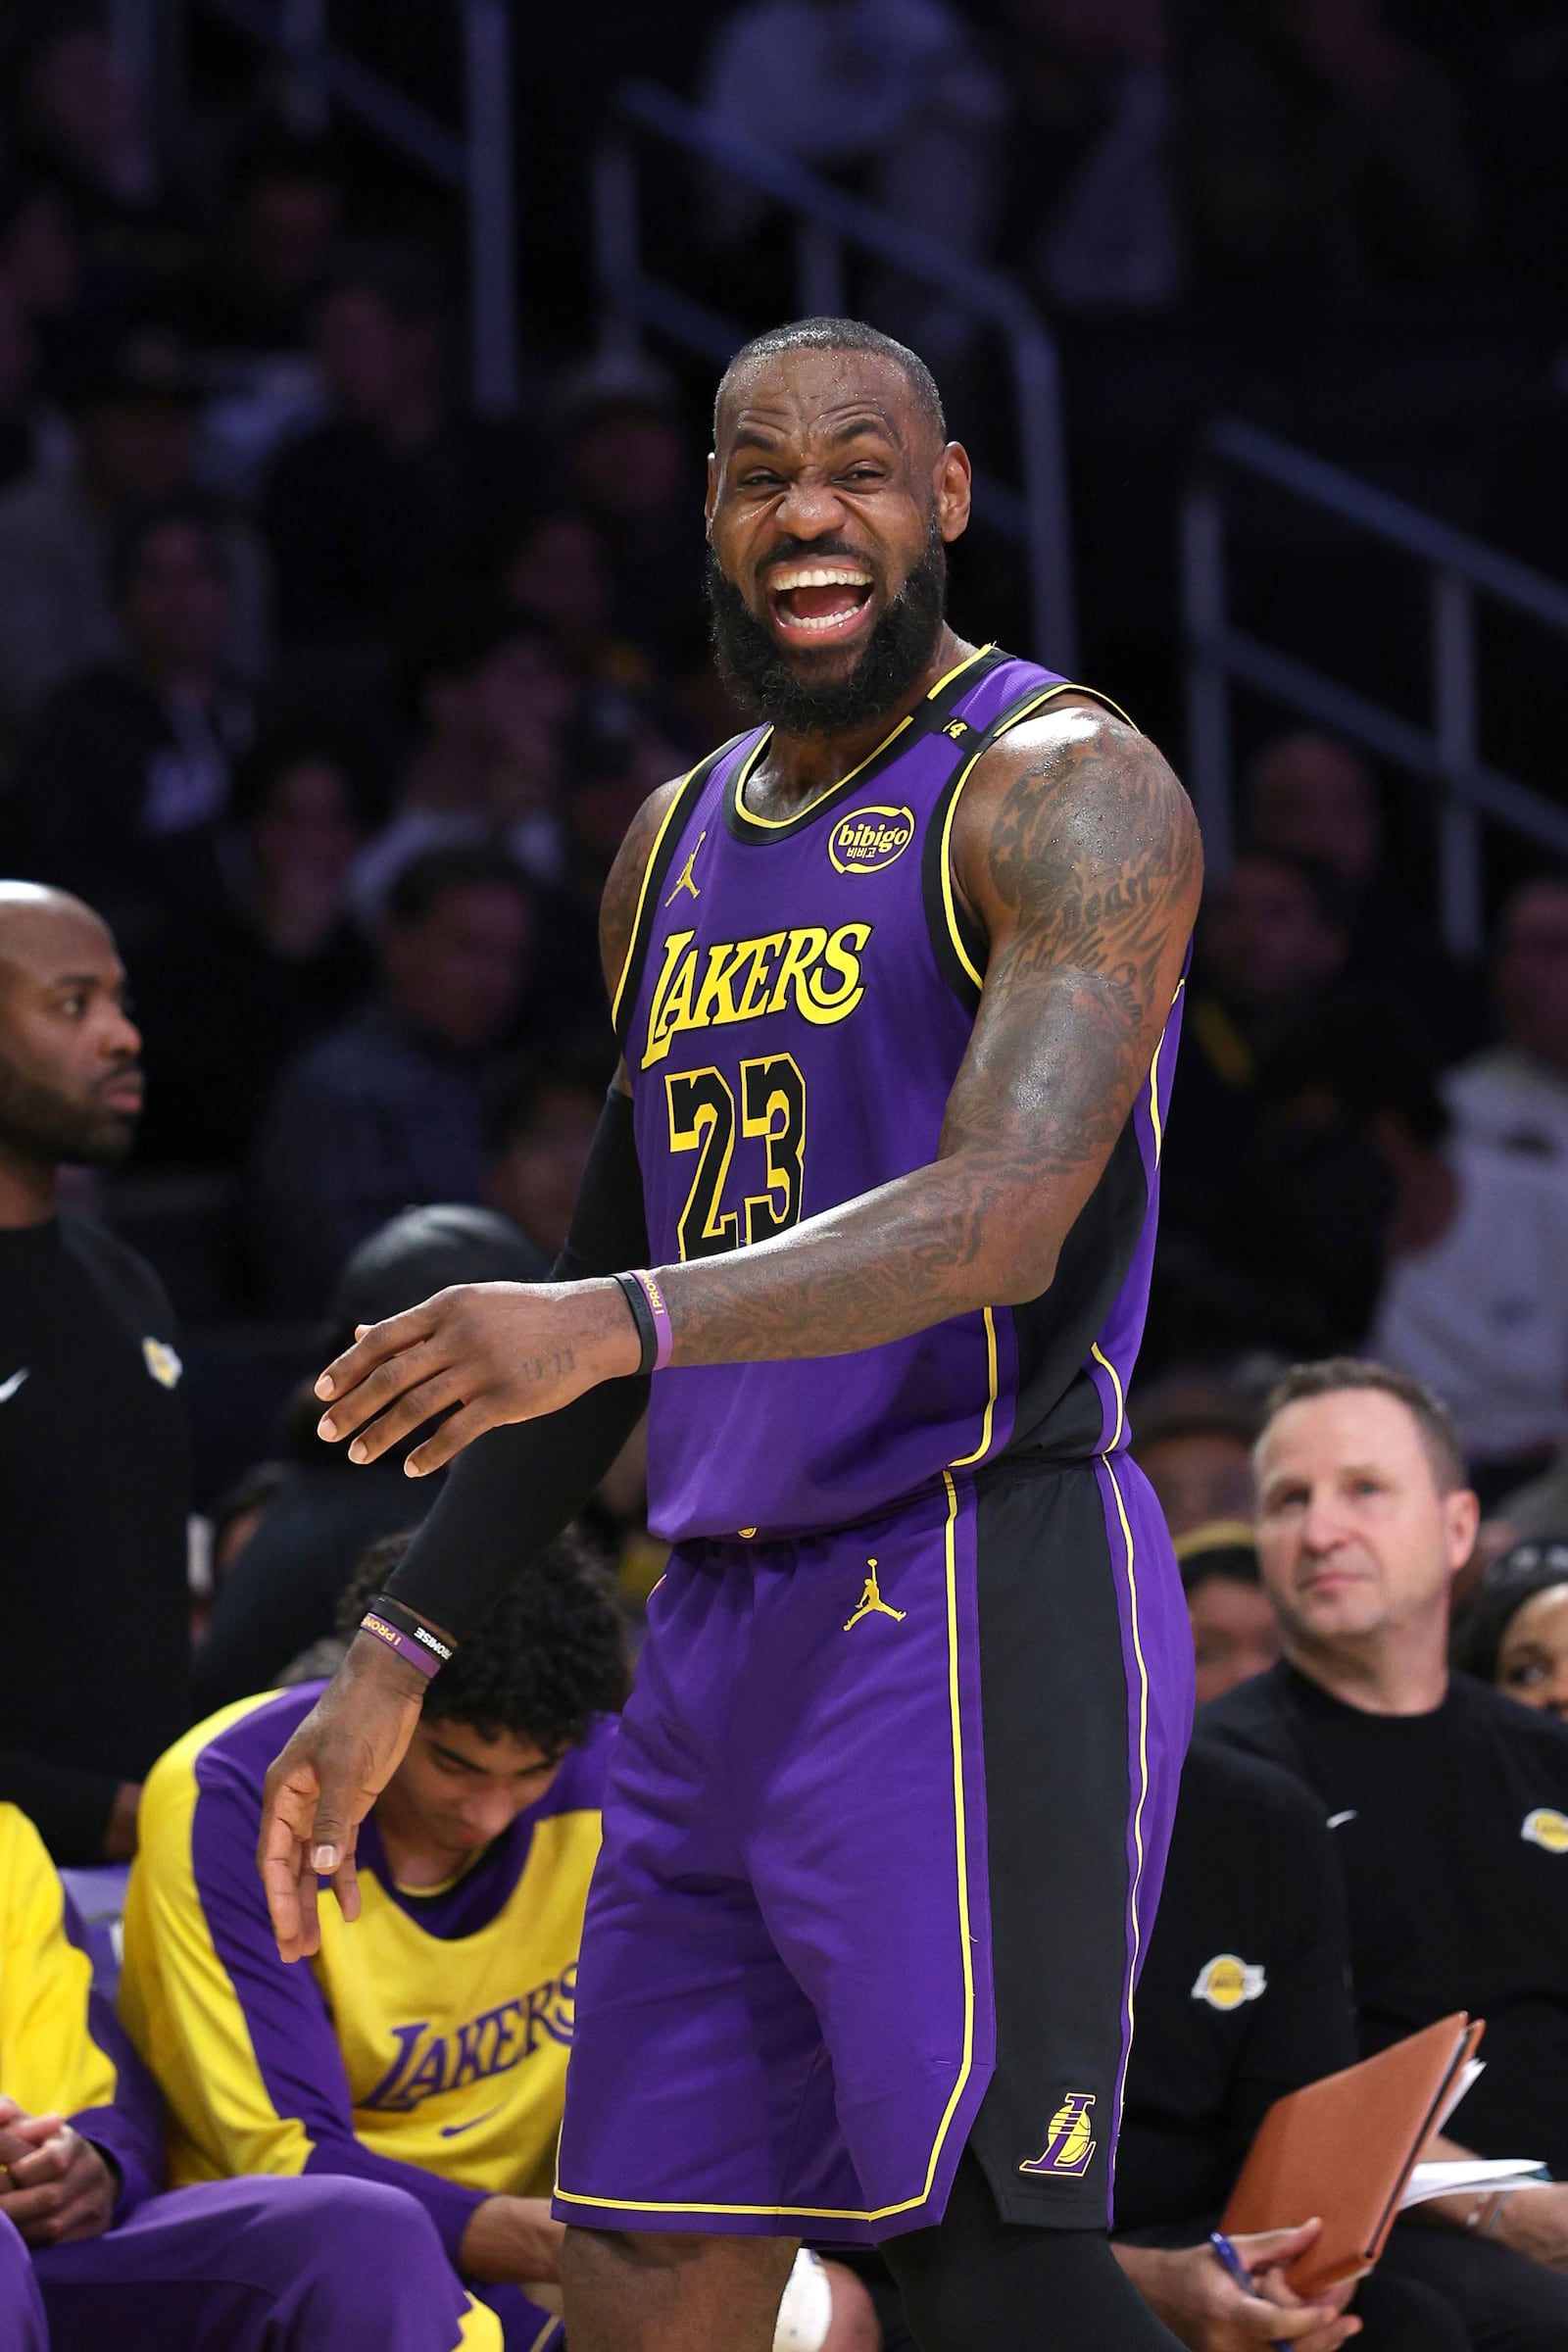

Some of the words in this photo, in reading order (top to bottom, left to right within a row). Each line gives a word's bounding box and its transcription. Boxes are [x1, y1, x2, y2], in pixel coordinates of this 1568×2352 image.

[839, 824, 908, 853] bibigo
[847, 848, 876, 858] 비비고
[641, 922, 873, 1072] LAKERS
[663, 1052, 807, 1263] 23
